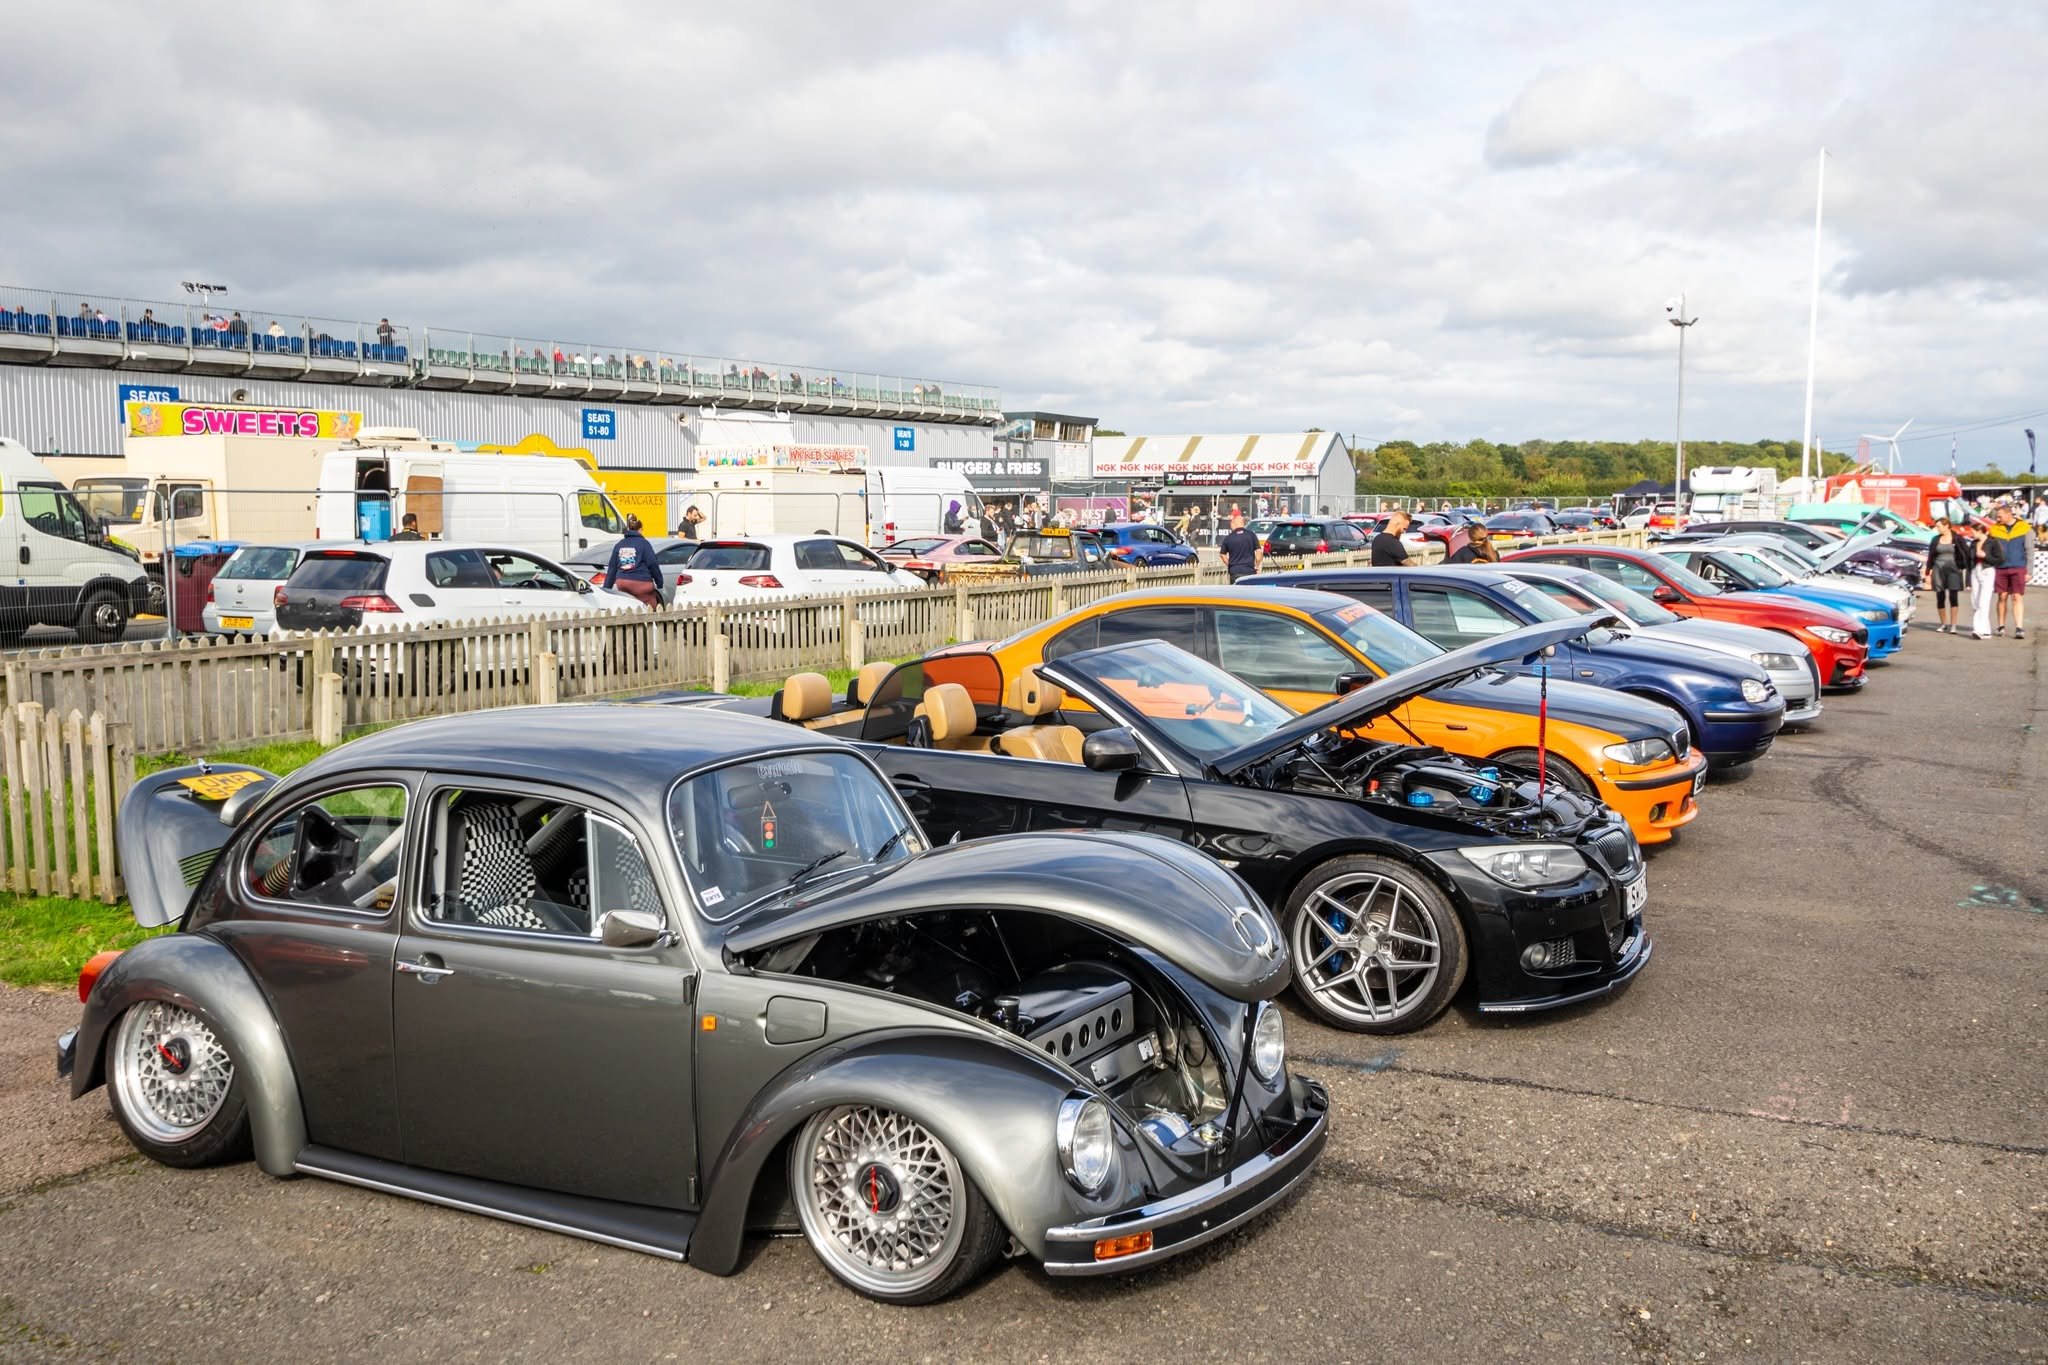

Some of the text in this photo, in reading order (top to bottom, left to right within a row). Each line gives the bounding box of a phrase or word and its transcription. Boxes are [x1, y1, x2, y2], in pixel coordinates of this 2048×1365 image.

[129, 389, 170, 402] SEATS
[182, 408, 319, 437] SWEETS
[587, 413, 610, 423] SEATS
[588, 425, 609, 436] 51-80
[897, 430, 911, 438] SEATS
[789, 448, 822, 461] WICKED
[994, 462, 1004, 475] &
[1007, 462, 1042, 475] FRIES
[1096, 462, 1316, 472] NGK NGK NGK NGK NGK NGK NGK NGK NGK
[1167, 473, 1184, 481] The
[1186, 473, 1230, 481] Container
[619, 495, 663, 506] PANCAKES
[1081, 508, 1127, 520] KESTEL
